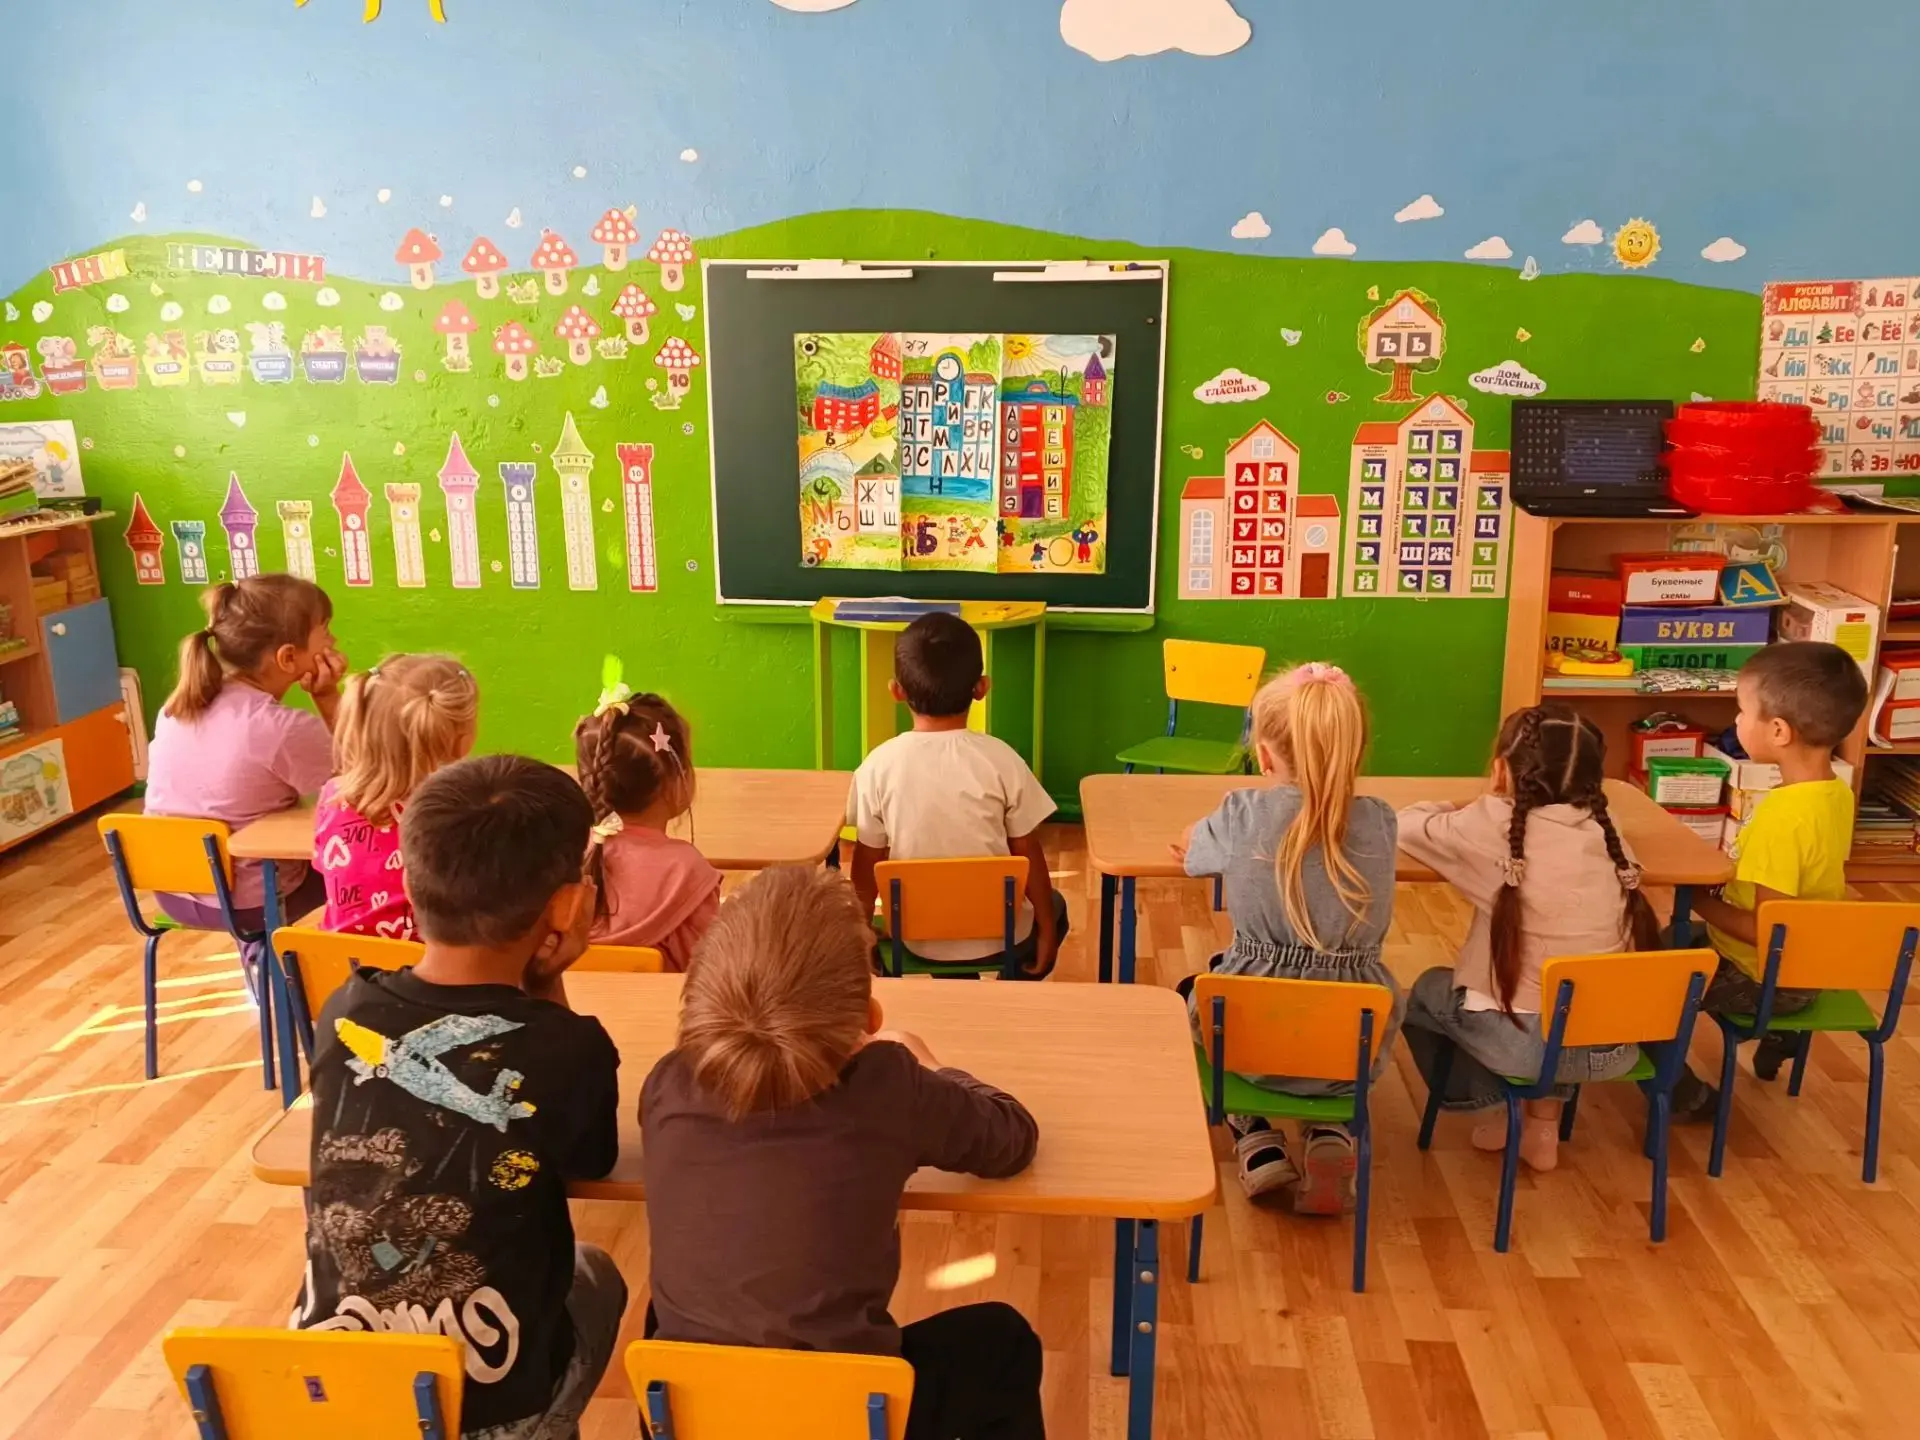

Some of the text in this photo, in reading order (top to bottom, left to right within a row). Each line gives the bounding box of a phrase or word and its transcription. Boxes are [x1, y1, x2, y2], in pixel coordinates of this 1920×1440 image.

[610, 248, 620, 262] 7
[51, 243, 326, 295] ДНИ НЕДЕЛИ
[416, 268, 425, 282] 1
[667, 269, 678, 284] 9
[482, 277, 491, 290] 3
[552, 273, 561, 287] 5
[1795, 285, 1833, 295] РУССКИЙ
[1778, 295, 1849, 312] АЛФАВИТ
[1882, 290, 1905, 307] Аа
[632, 322, 643, 336] 8
[1783, 320, 1902, 346] Дд Ее Ёё
[453, 337, 462, 350] 2
[576, 343, 585, 356] 6
[1380, 337, 1426, 352] Ъ Ь
[511, 359, 522, 373] 4
[1784, 357, 1898, 377] Йй Кк Лл
[669, 373, 689, 387] 10
[1497, 369, 1521, 379] ДОМ
[1220, 378, 1243, 388] ДОМ
[1474, 375, 1541, 390] СОГЛАСНЫХ
[935, 383, 947, 402] Р
[1205, 384, 1258, 397] ГЛАСНЫХ
[902, 390, 992, 409] Б П Г К
[1828, 391, 1849, 410] Рр
[1877, 390, 1896, 407] Сс
[948, 402, 958, 421] Й
[1007, 406, 1017, 421] А
[902, 417, 993, 438] Д Т В Ф
[1822, 425, 1845, 443] Цц
[1872, 422, 1892, 440] Чч
[933, 428, 949, 447] М
[1008, 428, 1018, 443] О
[1412, 435, 1456, 450] П Б
[902, 445, 990, 473] З С Х Ц
[943, 454, 955, 474] Л
[1006, 454, 1016, 468] У
[1239, 466, 1284, 483] А Я
[1365, 462, 1454, 478] Л Ф В
[1005, 475, 1057, 488] Ы И
[860, 481, 895, 502] Ж Ч
[1362, 491, 1498, 506] М К Г Х
[1004, 497, 1058, 513] Э Е
[1238, 493, 1281, 511] О Ё
[859, 509, 875, 526] Ш
[1238, 522, 1284, 537] У Ю
[1361, 518, 1496, 535] Н Т Д Ц
[1234, 549, 1280, 564] Ы И
[1361, 546, 1493, 561] Р Ш Ж Ч
[1235, 576, 1277, 590] Э Е
[1357, 572, 1494, 590] Й С З Щ
[1651, 577, 1704, 590] Буквенные
[1732, 568, 1776, 599] А
[1660, 592, 1691, 600] схемы
[1657, 621, 1735, 639] БУКВЫ
[1658, 653, 1728, 669] СЛОГИ
[342, 825, 375, 852] LOVE
[335, 876, 363, 907] LOVE
[307, 1382, 323, 1399] 2
